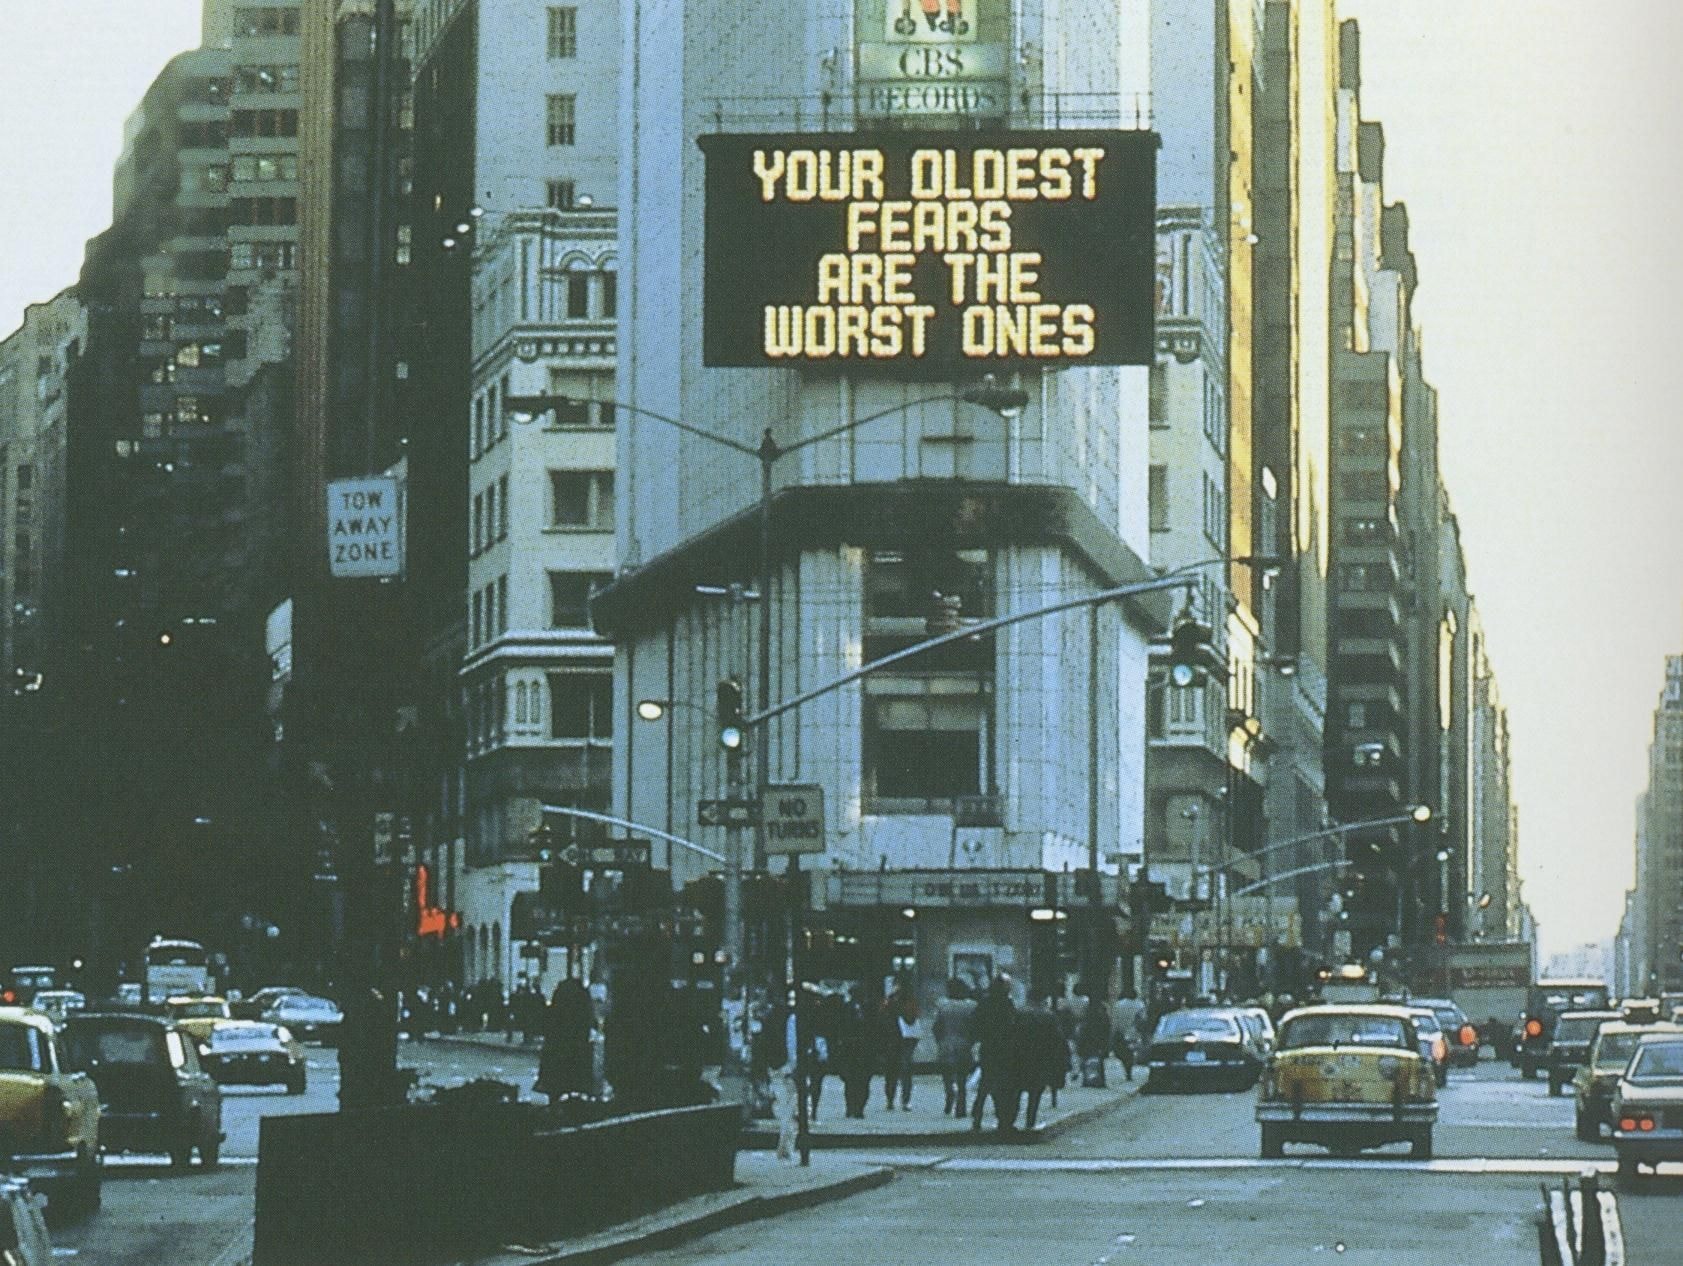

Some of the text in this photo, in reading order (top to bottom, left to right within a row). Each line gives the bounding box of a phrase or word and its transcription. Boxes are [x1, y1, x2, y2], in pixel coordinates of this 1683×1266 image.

[898, 46, 964, 78] CBS
[869, 85, 998, 112] RECORDS
[752, 148, 1105, 201] YOUR OLDEST
[847, 201, 1012, 252] FEARS
[818, 252, 1041, 304] ARE THE
[764, 304, 1095, 358] WORST ONES
[342, 491, 382, 510] TOW
[334, 517, 391, 536] AWAY
[335, 542, 393, 563] ZONE
[778, 798, 807, 817] NO
